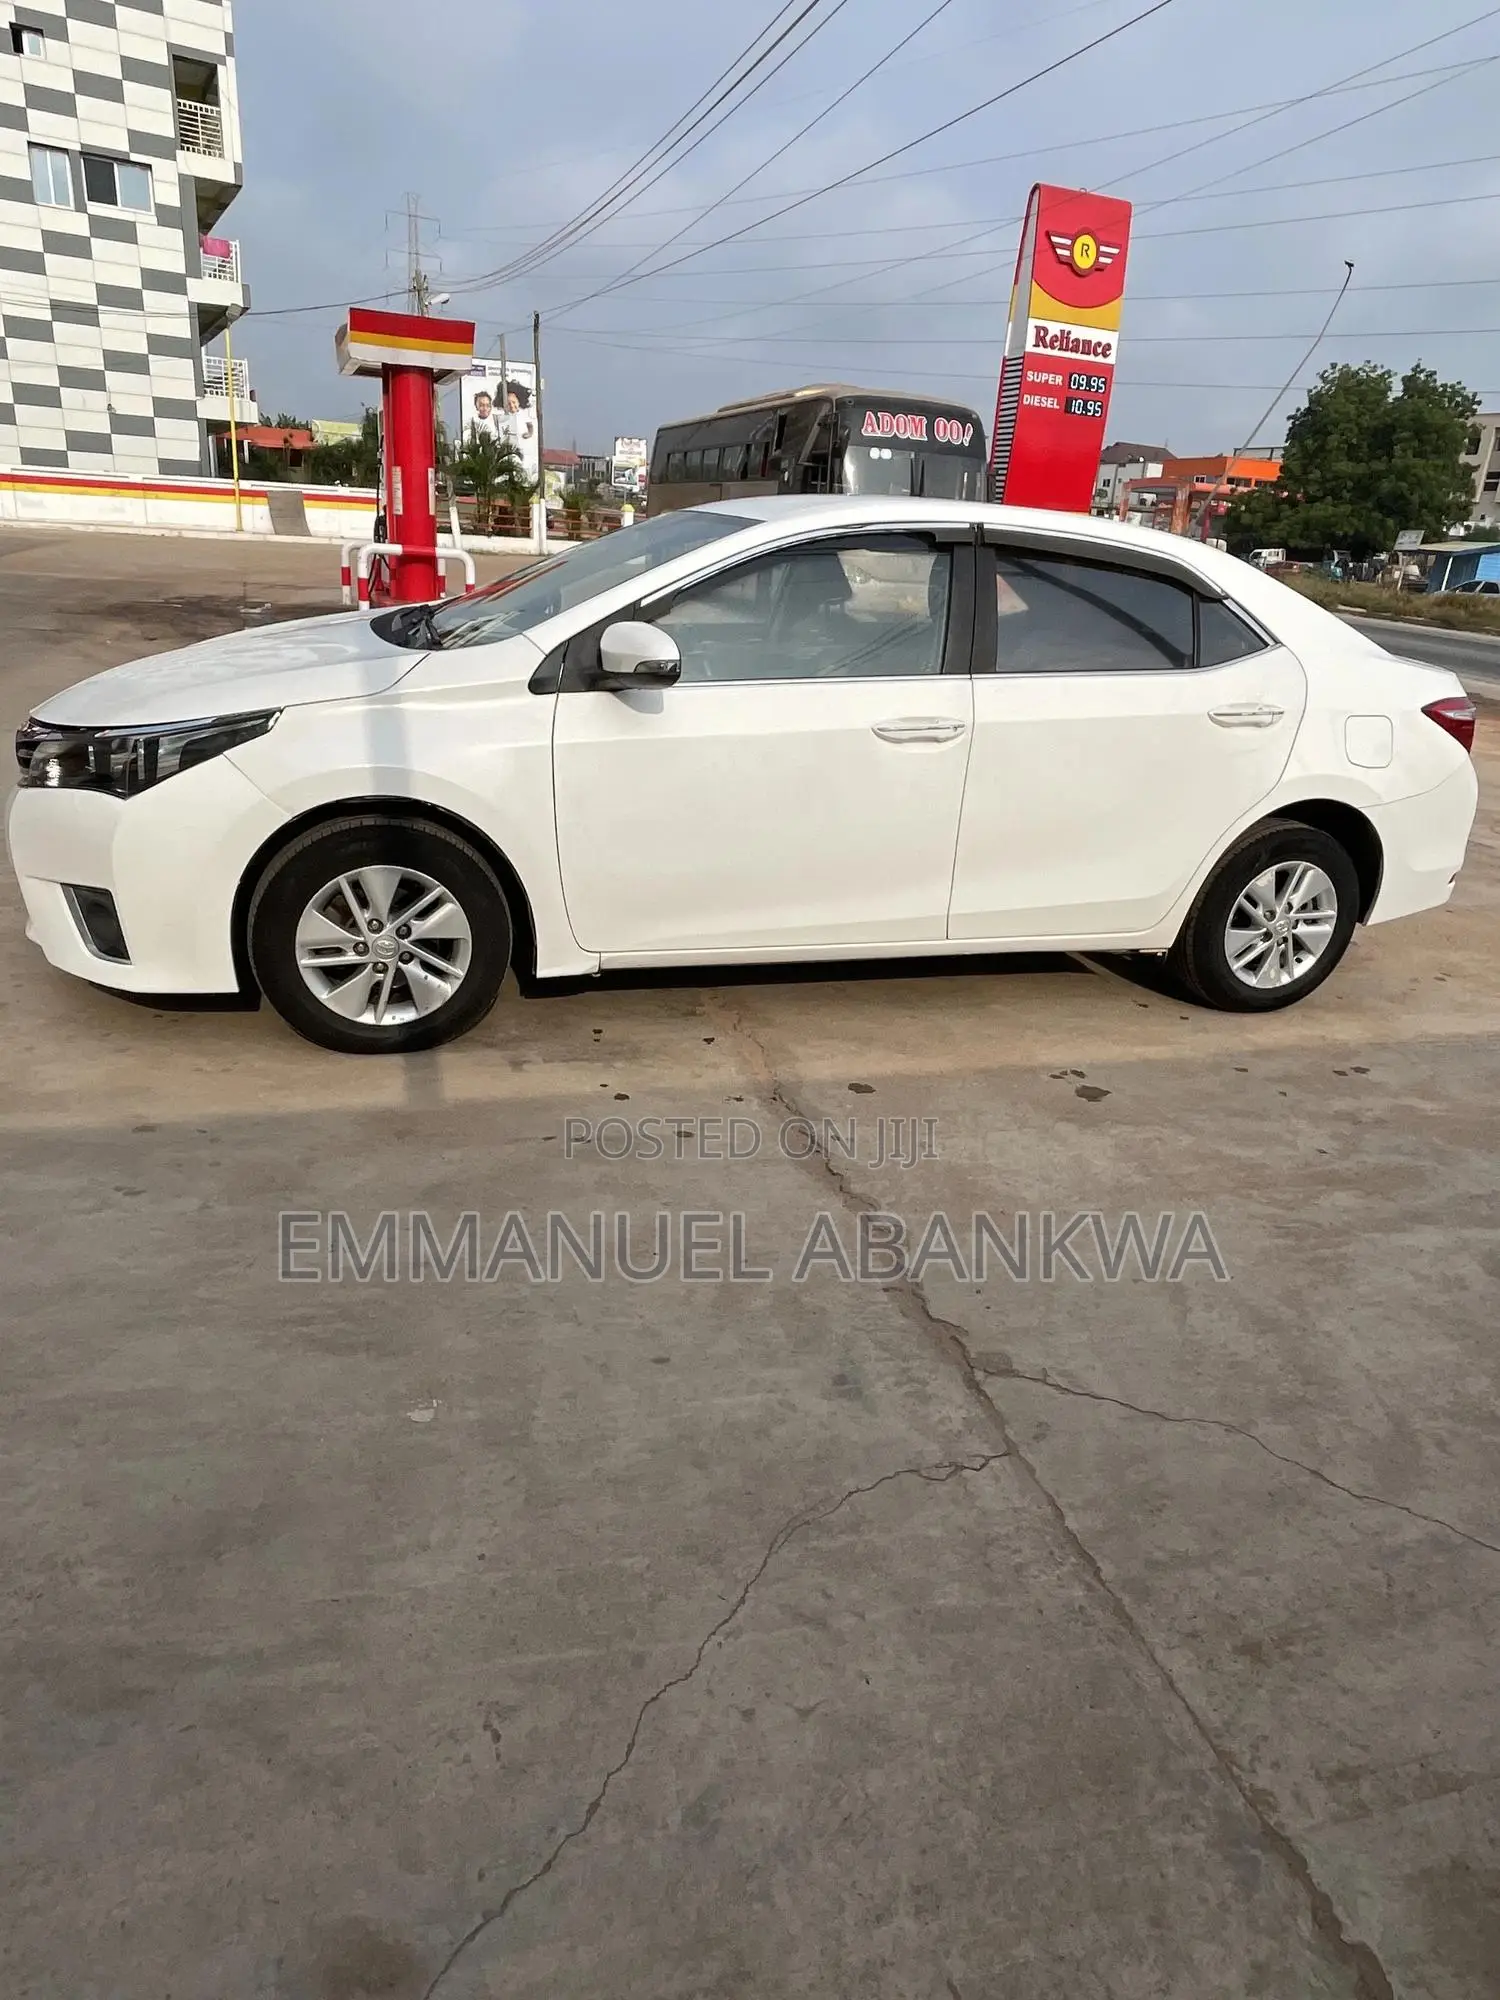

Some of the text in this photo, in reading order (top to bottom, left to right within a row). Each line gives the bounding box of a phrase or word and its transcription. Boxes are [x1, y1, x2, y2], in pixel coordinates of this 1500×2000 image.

[1080, 243, 1090, 259] R
[1032, 325, 1112, 358] Reliance
[1026, 370, 1106, 393] SUPER 09.95
[1023, 394, 1102, 417] DIESEL 10.95
[861, 411, 928, 441] ADOM
